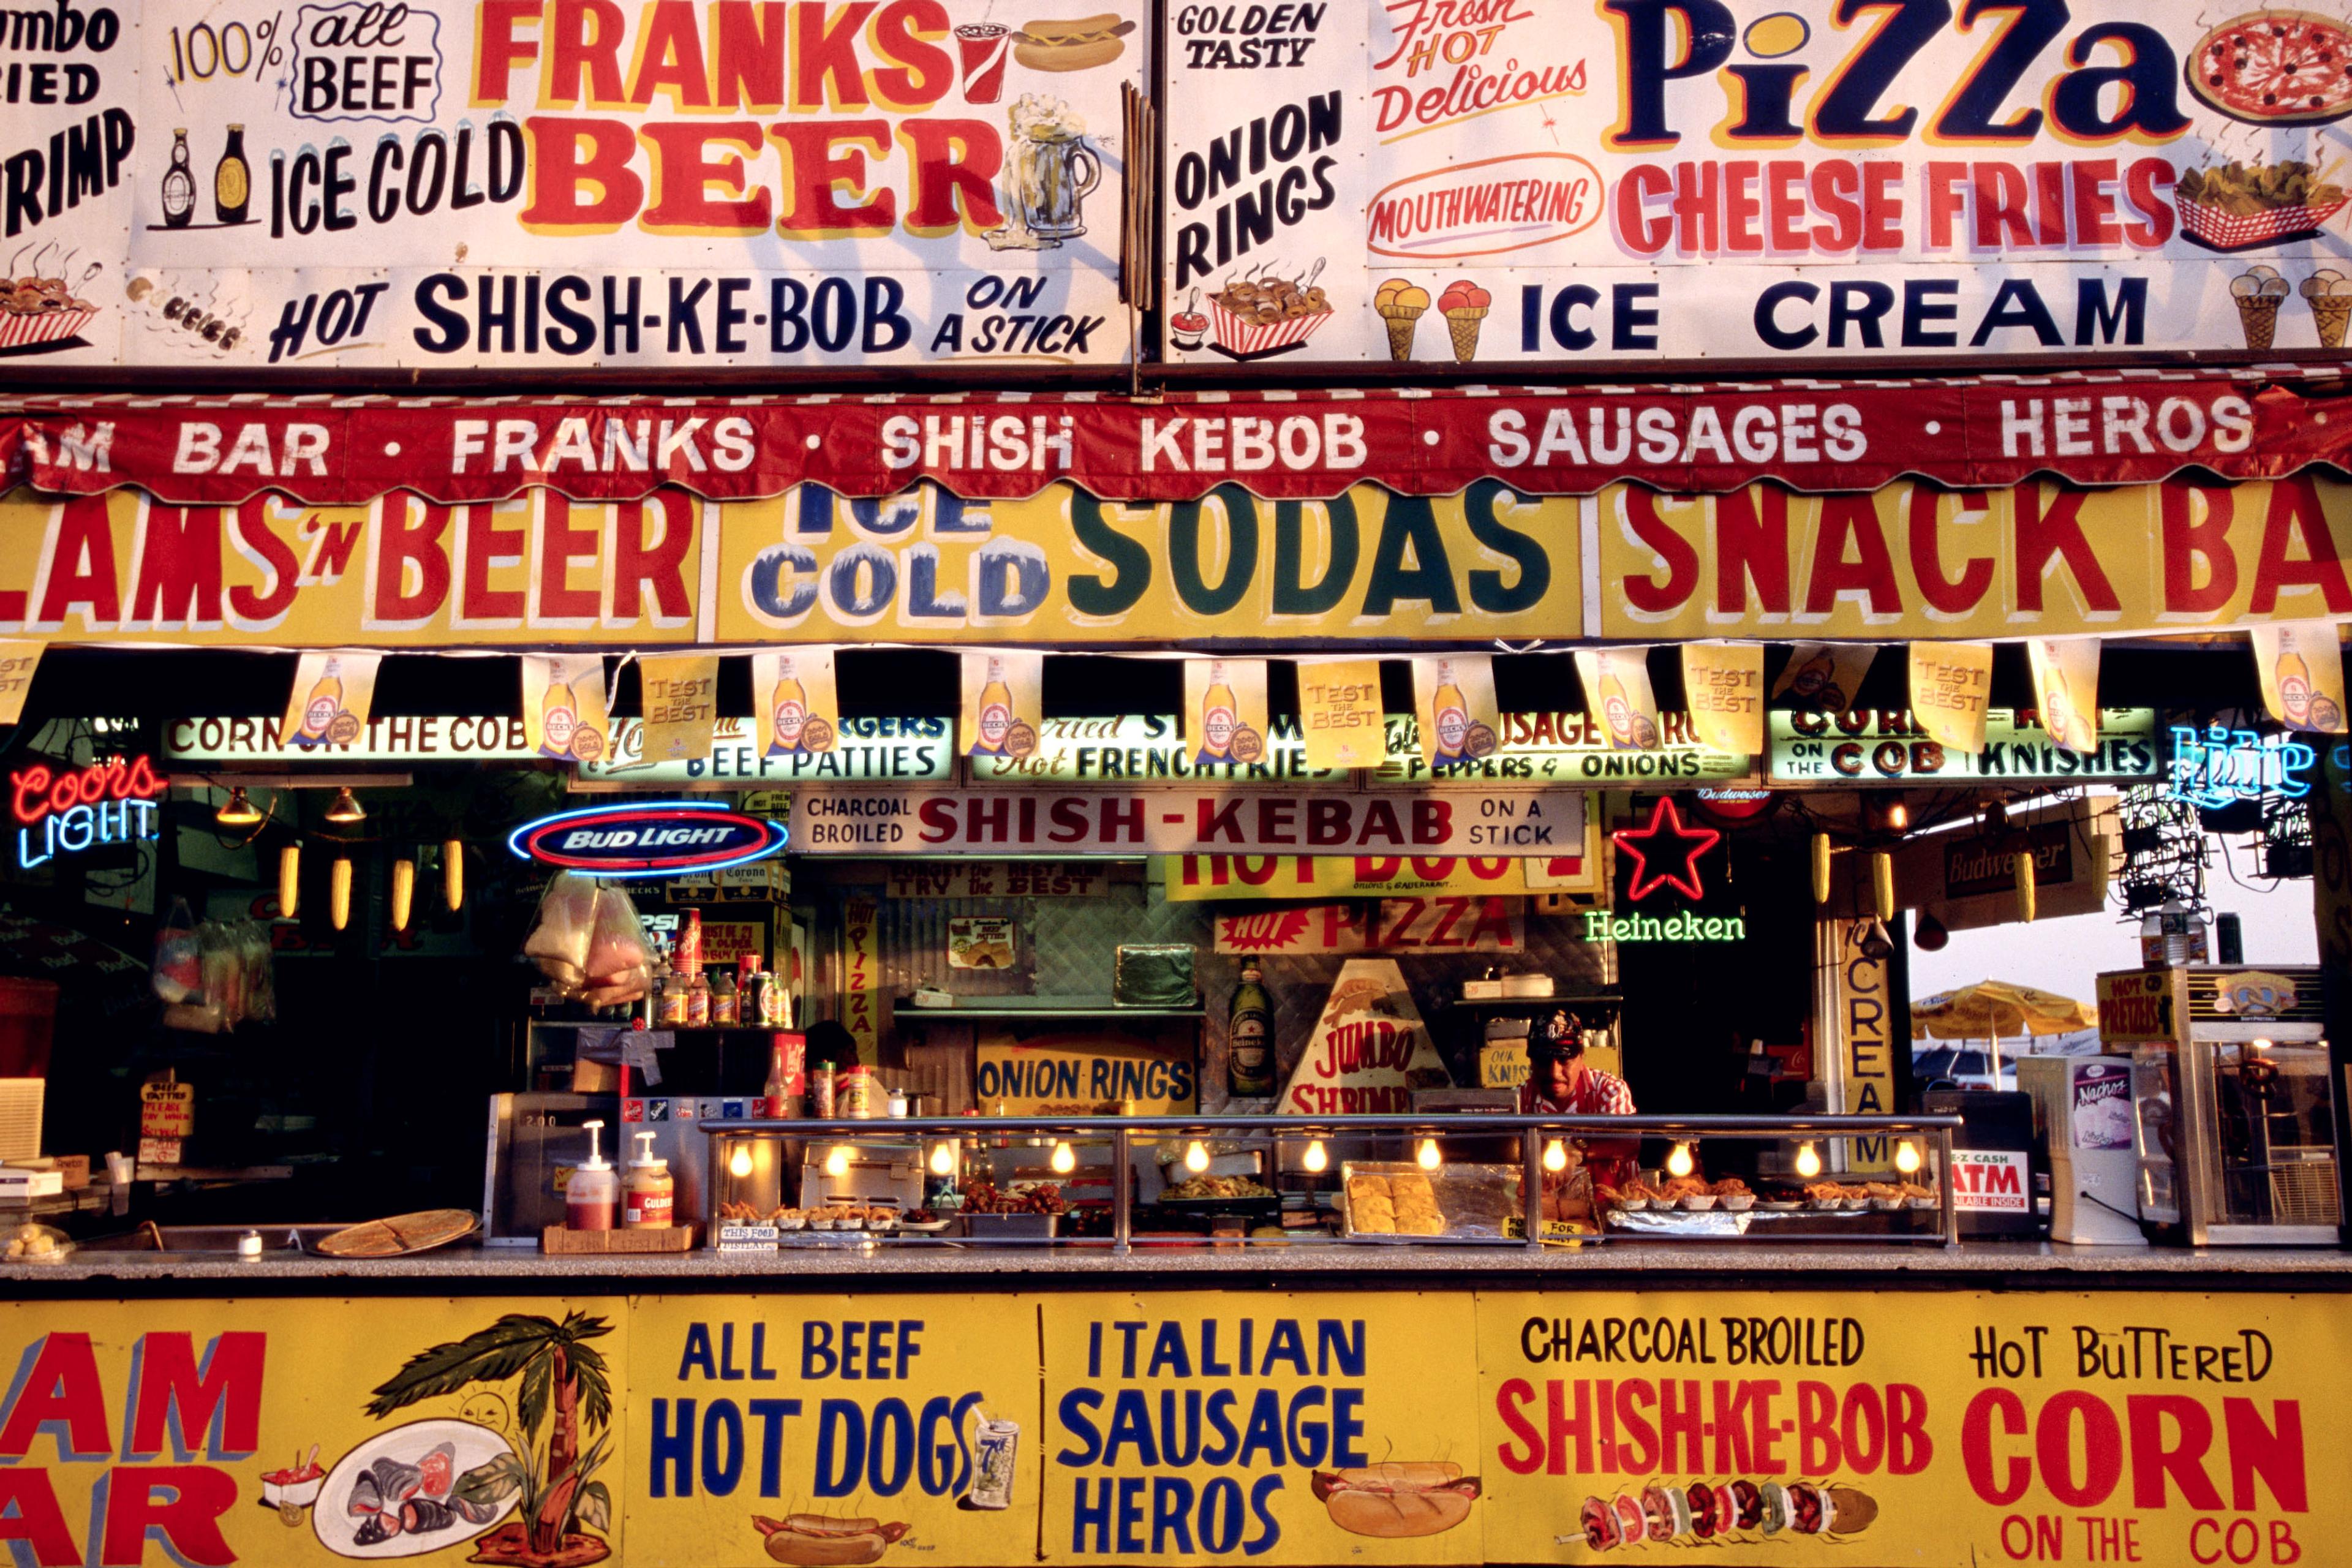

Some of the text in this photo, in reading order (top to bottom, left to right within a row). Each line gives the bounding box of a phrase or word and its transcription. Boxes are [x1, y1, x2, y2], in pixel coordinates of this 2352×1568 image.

[310, 2, 409, 48] all
[1177, 2, 1327, 36] GOLDEN
[1374, 0, 1534, 70] Fresh
[170, 11, 283, 83] 100%
[469, 0, 954, 114] FRANKS
[1186, 38, 1316, 69] TASTY
[1406, 25, 1505, 78] HOT
[0, 64, 100, 104] IED
[302, 56, 433, 113] BEEF
[1372, 59, 1587, 133] Delicious
[1175, 90, 1343, 210] ONION
[0, 108, 136, 238] RIMP
[270, 119, 525, 238] ICE COLD
[518, 116, 1005, 240] BEER
[1175, 156, 1338, 291] RINGS
[1369, 179, 1589, 243] MOUTHWATERING
[1615, 158, 2176, 259] CHEESE FRIES
[966, 276, 1048, 309] ON
[268, 273, 911, 363] HOT SHISH-KE-BOB
[931, 314, 1105, 353] A STICK
[1521, 277, 2148, 352] ICE CREAM
[0, 396, 2252, 476] AM BAR FRANKS SHISH KEBOB SAUSAGES HEROS
[363, 494, 692, 631] BEER
[1067, 484, 1551, 617] SODAS
[1624, 483, 2122, 614] SNACK
[744, 541, 1050, 626] COLD
[650, 678, 711, 699] TEST
[1306, 683, 1373, 703] TEST
[1691, 667, 1756, 688] TEST
[1917, 659, 1983, 685] TEST
[650, 705, 710, 723] BEST
[1311, 710, 1376, 729] BEST
[1695, 695, 1755, 713] BEST
[1920, 688, 1982, 711] BEST
[168, 717, 529, 752] CORN THE COB
[1792, 744, 1823, 757] ON
[687, 745, 935, 777] BEEF PATTIES
[1581, 753, 1700, 777] ONIONS
[1787, 762, 1823, 774] THE
[1831, 740, 2152, 776] COB KNISHES
[11, 755, 168, 822] Coors
[807, 797, 911, 817] CHARCOAL
[1481, 799, 1542, 818] ON A
[18, 797, 159, 868] LIGHT
[563, 827, 736, 850] BUD LIGHT
[812, 823, 903, 843] BROILED
[1469, 825, 1554, 845] STICK
[726, 866, 765, 877] Corona
[1949, 843, 2065, 883] Budweer
[892, 878, 950, 895] TRY
[1007, 877, 1094, 895] BEST
[848, 902, 876, 924] HOT
[1234, 895, 1513, 948] HOT PIZZA
[1585, 911, 1746, 941] Heineken
[848, 927, 872, 1033] PIZZA
[2111, 978, 2141, 997] HOT
[1315, 1021, 1415, 1079] JUMBO
[1847, 957, 1888, 1163] CREAM
[979, 1058, 1192, 1101] ONION RINGS
[1488, 1065, 1531, 1084] KNIS
[2079, 1080, 2126, 1106] Nachos
[1288, 1084, 1409, 1114] SHRIMP
[1952, 1164, 2021, 1194] ATM
[1953, 1196, 2022, 1207] AILABLE INSIDE
[724, 1228, 774, 1237] THIS FOOD
[1551, 1223, 1575, 1233] FOR
[678, 1319, 924, 1381] ALL BEEF
[1089, 1318, 1365, 1378] ITALIAN
[1521, 1316, 1864, 1366] CHARCOAL BROILED
[1969, 1326, 2048, 1379] HOT
[650, 1391, 984, 1499] HOT DOGS
[1057, 1387, 1368, 1469] SAUSAGE
[1496, 1378, 1933, 1477] SHISH-KE-BOB
[1962, 1387, 2310, 1512] CORN
[1072, 1473, 1285, 1555] HEROS
[2000, 1515, 2301, 1566] ON THE COB
